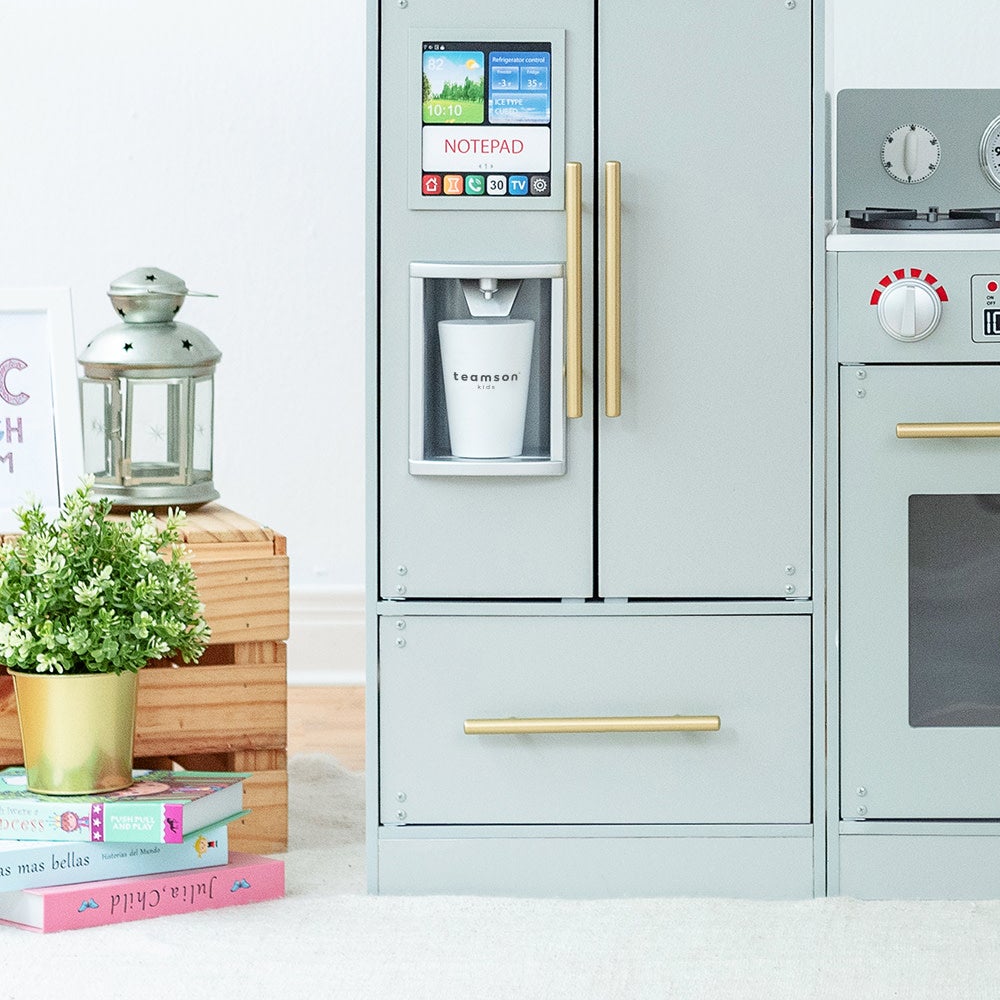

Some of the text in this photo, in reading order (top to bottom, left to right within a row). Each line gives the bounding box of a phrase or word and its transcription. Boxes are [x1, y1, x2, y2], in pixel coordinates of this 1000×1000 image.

[427, 59, 444, 71] 82
[492, 56, 524, 64] Refrigerator
[506, 98, 523, 106] TYPE
[427, 104, 463, 117] 10:10
[444, 138, 524, 154] NOTEPAD
[490, 180, 504, 191] 30
[511, 180, 526, 190] TV
[453, 371, 518, 382] teamson
[112, 822, 154, 831] AND PLAY
[18, 861, 45, 874] mas
[51, 851, 90, 870] bellas
